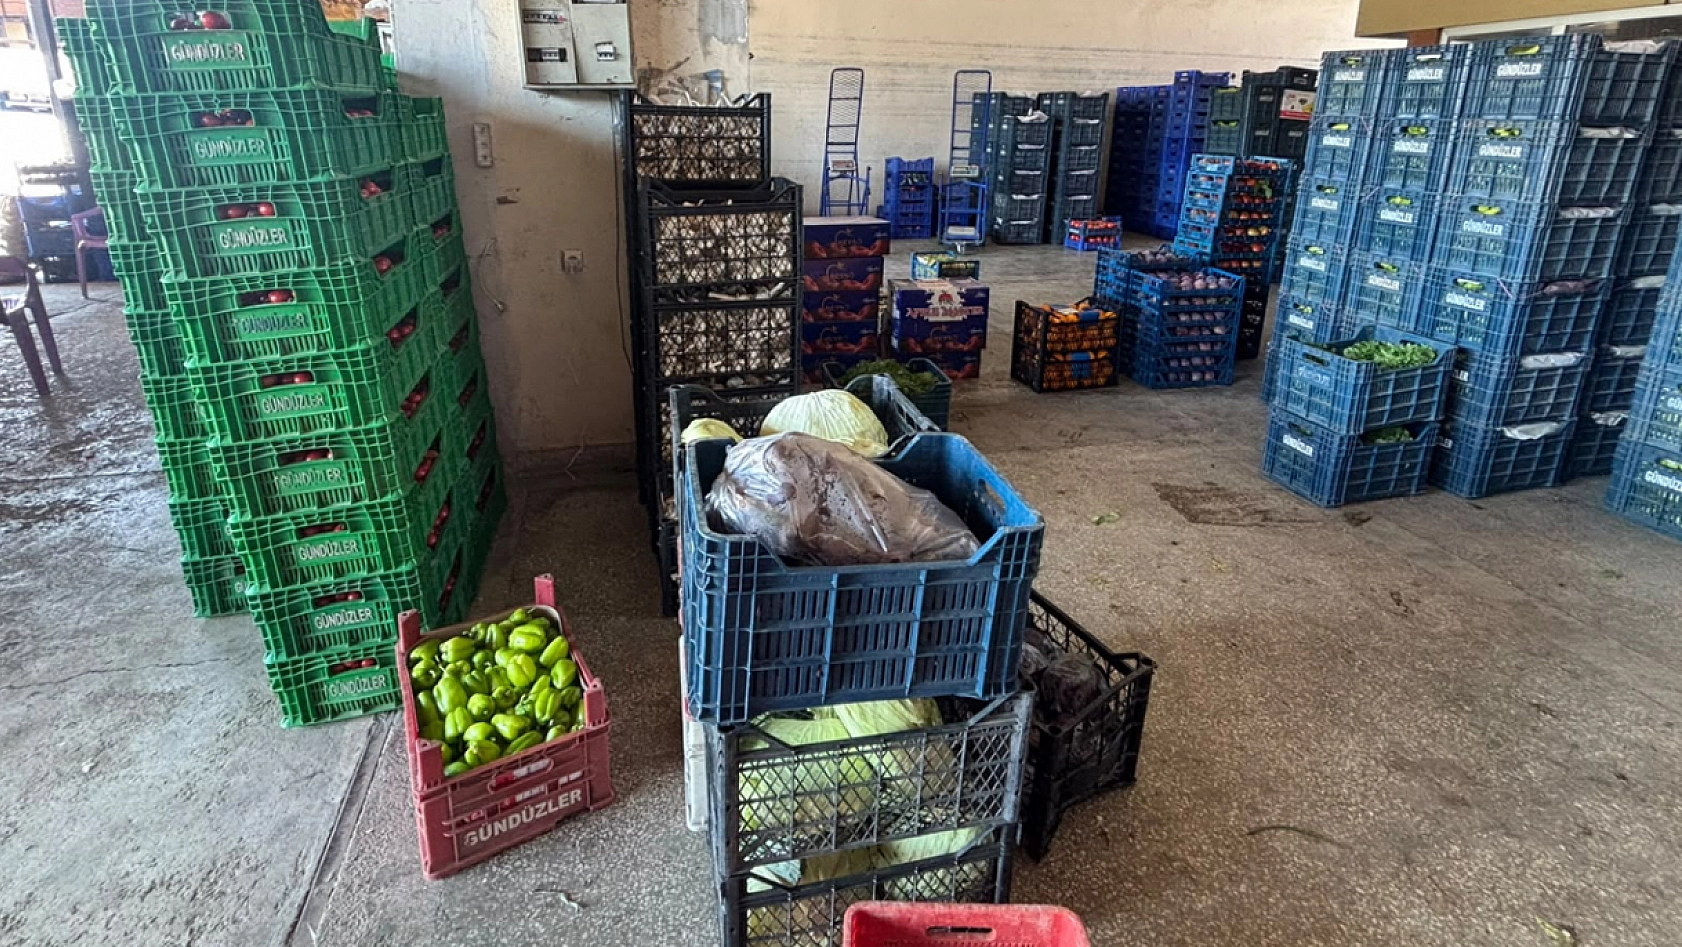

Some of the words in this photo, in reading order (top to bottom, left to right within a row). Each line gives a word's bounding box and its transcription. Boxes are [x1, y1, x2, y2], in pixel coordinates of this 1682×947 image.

[220, 227, 287, 249] GÜNDÜZLER
[1644, 471, 1682, 492] GÜNDÜZ
[300, 540, 359, 561] GÜNDÜZLER
[314, 608, 374, 629] GÜNDÜZLER
[330, 674, 387, 698] GÜNDÜZLER
[463, 788, 583, 847] GÜNDÜZLER
